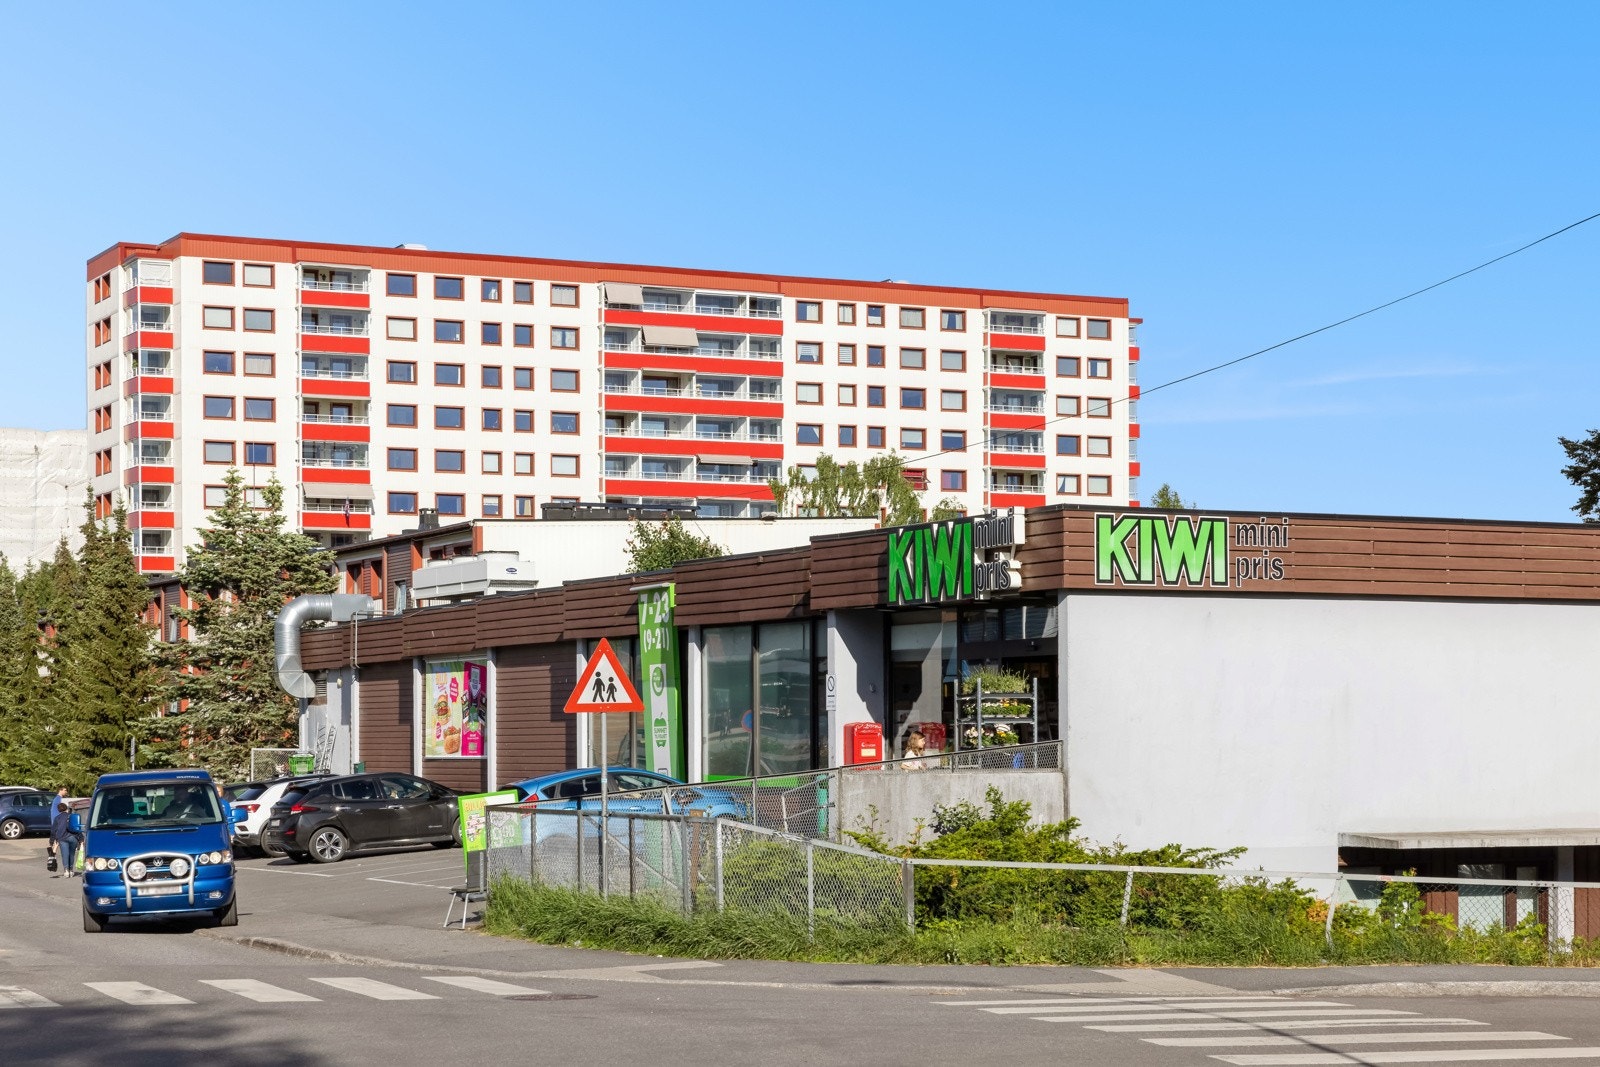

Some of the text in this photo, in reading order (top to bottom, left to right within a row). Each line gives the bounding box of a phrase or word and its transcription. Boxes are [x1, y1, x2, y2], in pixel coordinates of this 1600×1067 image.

[974, 506, 1015, 549] mini
[1236, 517, 1289, 547] mini
[888, 519, 972, 604] KIWI
[1095, 513, 1229, 587] KIWI
[1236, 550, 1285, 587] pris
[974, 552, 1012, 600] pris
[640, 591, 670, 625] 7-23
[643, 627, 670, 653] (9-21)
